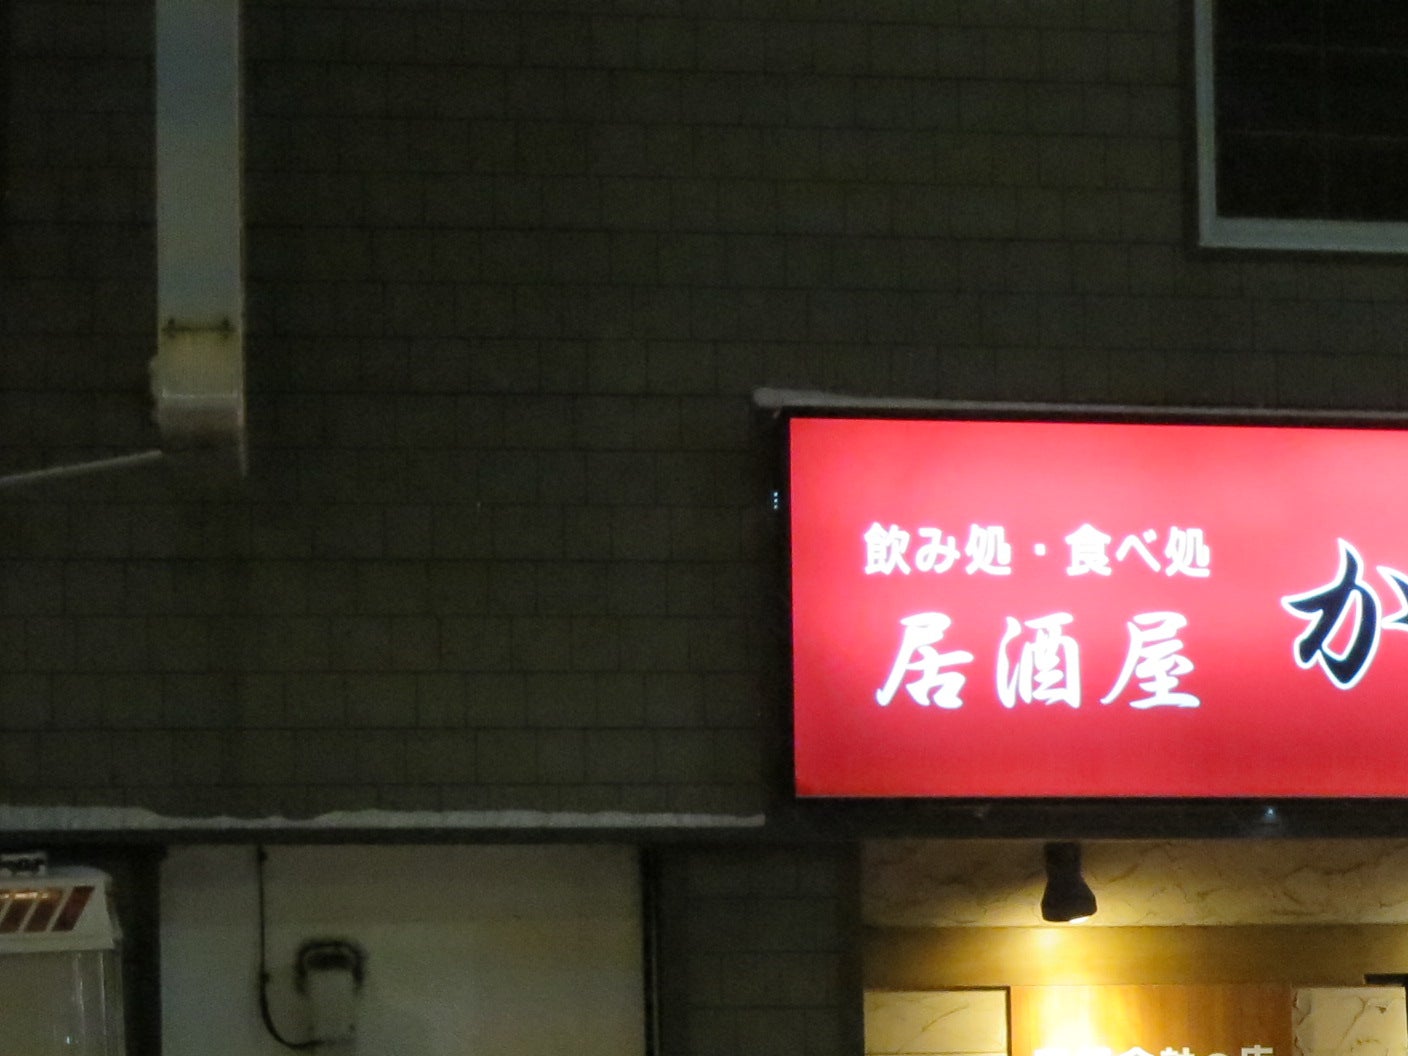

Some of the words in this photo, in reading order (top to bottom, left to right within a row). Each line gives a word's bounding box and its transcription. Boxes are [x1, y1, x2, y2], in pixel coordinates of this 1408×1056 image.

[863, 522, 1211, 578] 飲み処・食べ処
[875, 610, 1201, 710] 居酒屋
